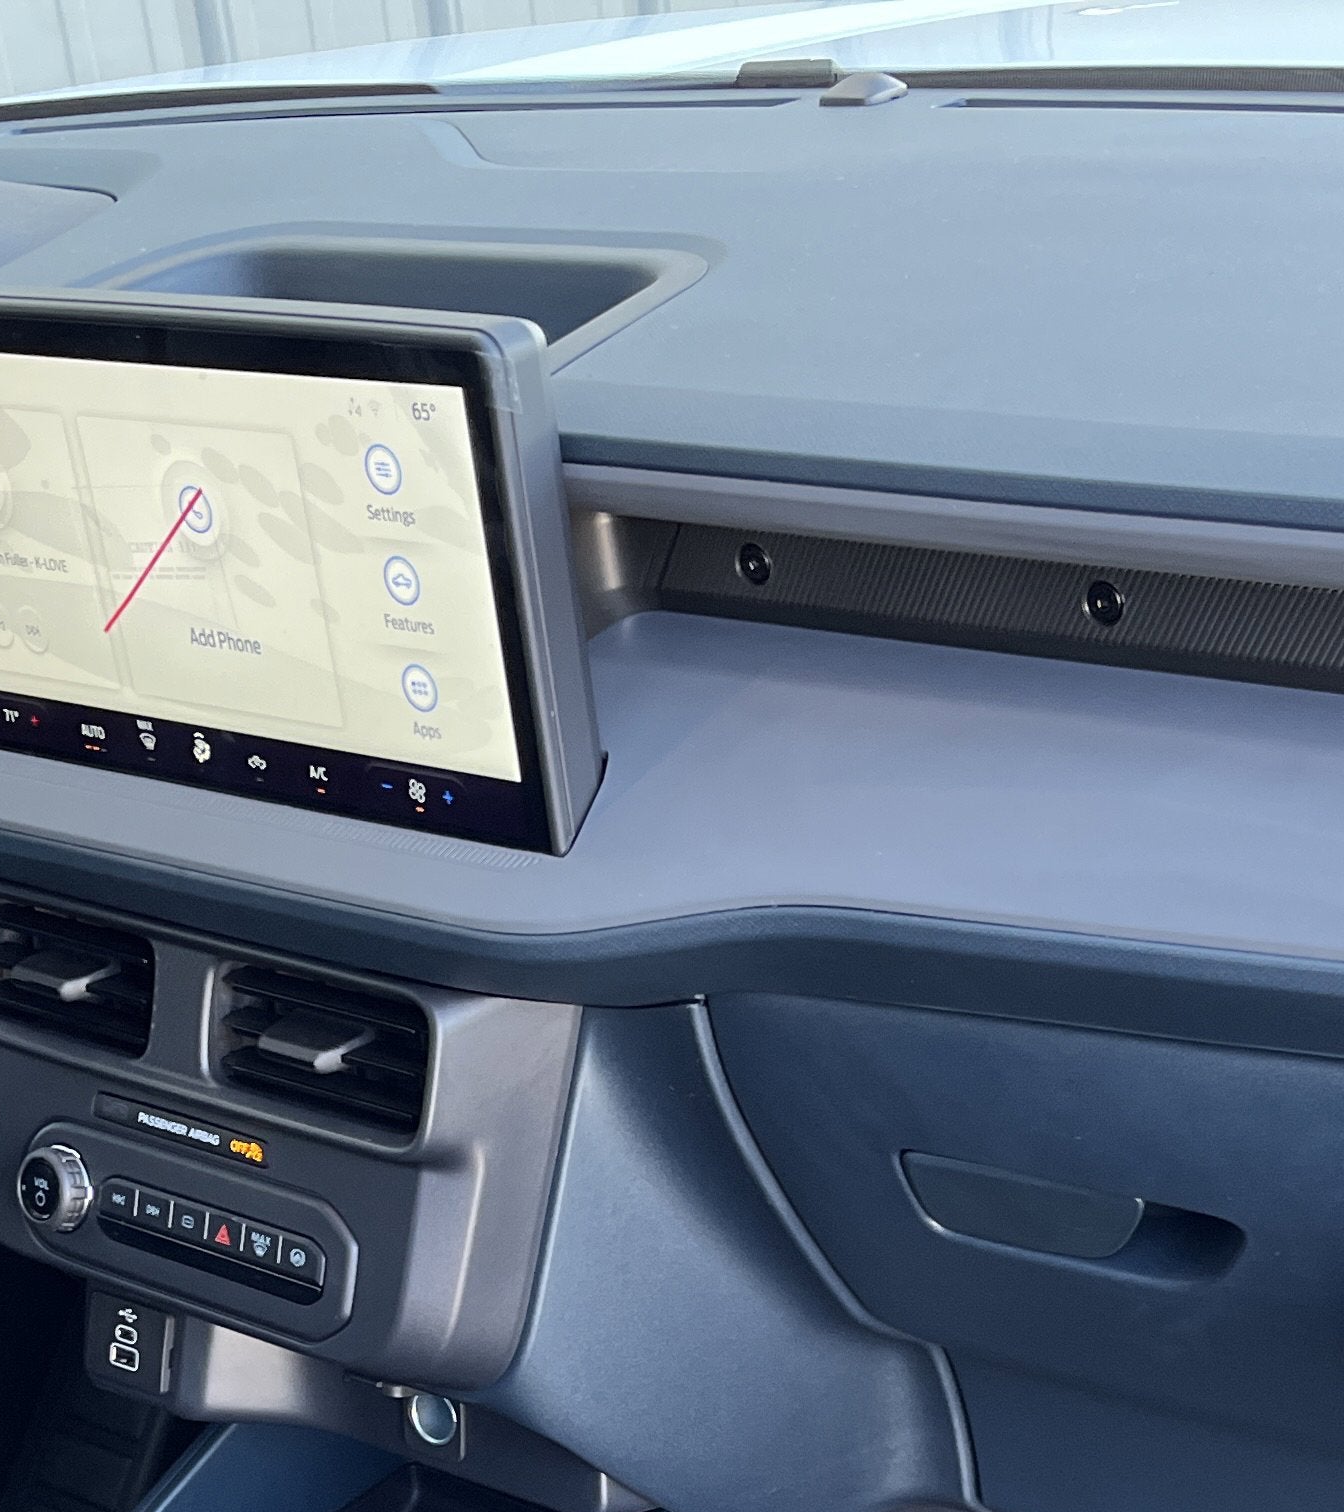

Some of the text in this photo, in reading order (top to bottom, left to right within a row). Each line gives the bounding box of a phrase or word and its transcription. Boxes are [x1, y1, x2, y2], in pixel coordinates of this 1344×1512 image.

[367, 504, 416, 527] Settings
[384, 613, 435, 635] Features
[190, 627, 262, 655] Add Phone
[81, 723, 106, 740] AUTO
[413, 721, 442, 740] Apps
[137, 1111, 188, 1137] PASSENGER
[187, 1127, 220, 1146] AIRBAG
